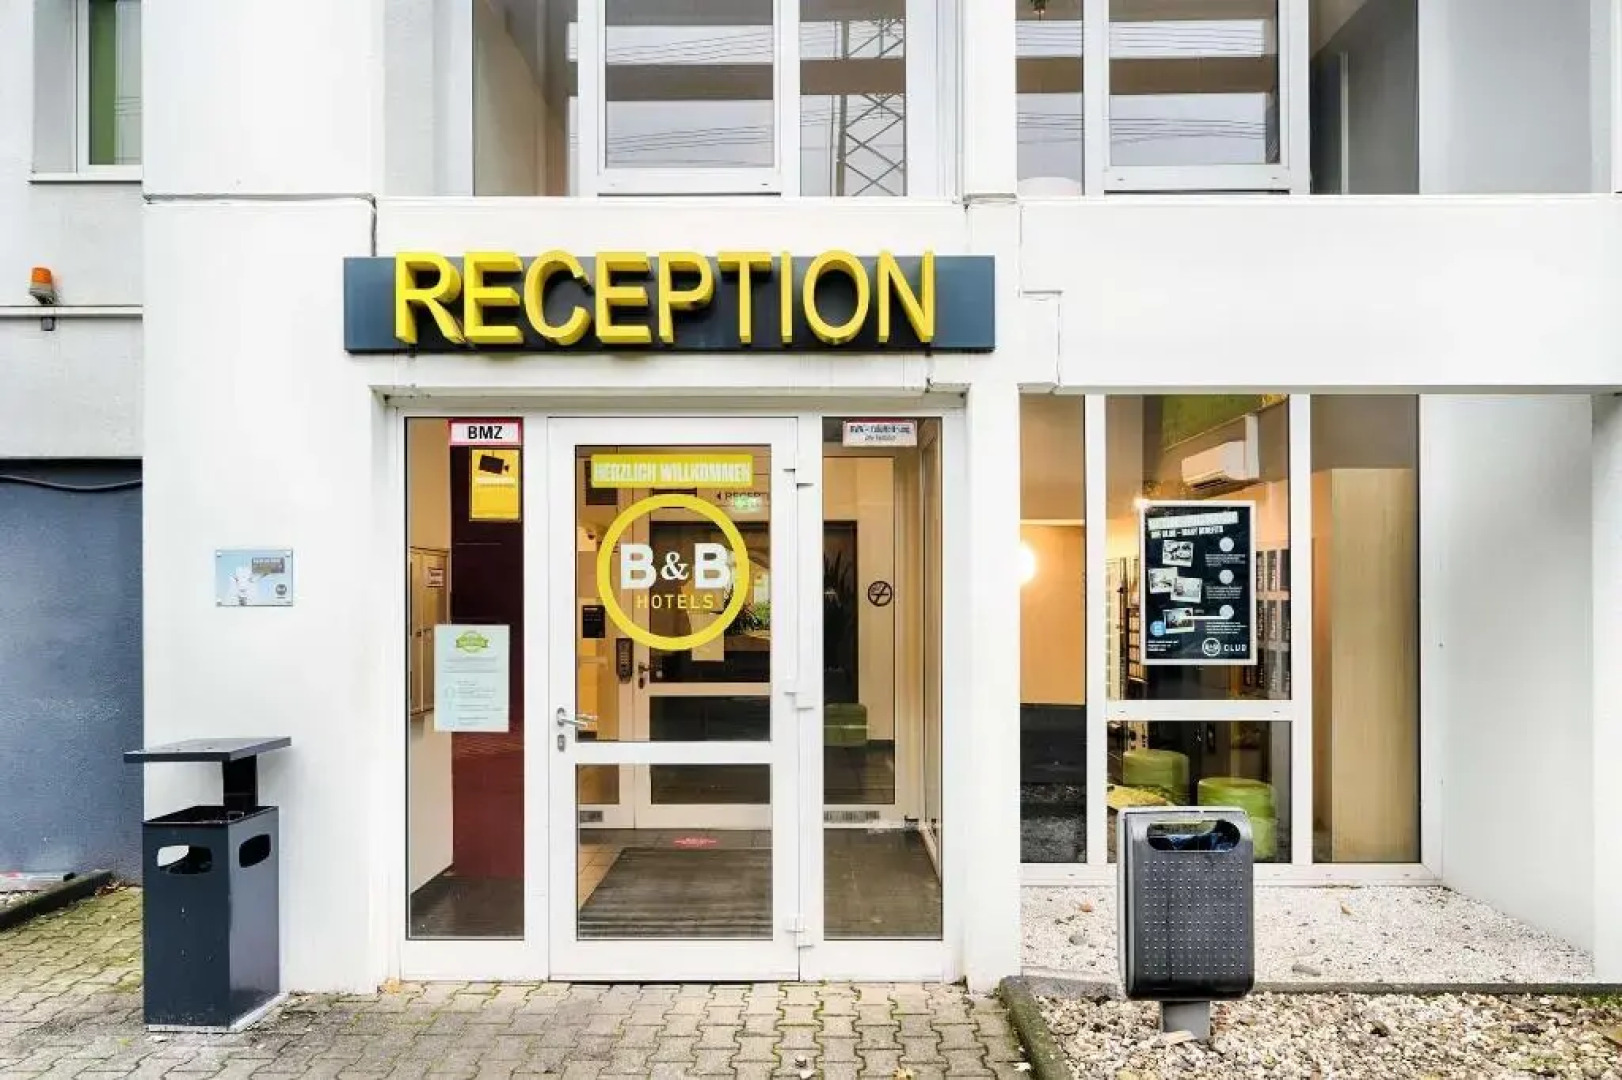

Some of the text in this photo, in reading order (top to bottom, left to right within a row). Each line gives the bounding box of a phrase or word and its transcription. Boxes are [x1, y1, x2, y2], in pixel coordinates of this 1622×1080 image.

[394, 250, 937, 346] RECEPTION
[467, 425, 503, 440] BMZ
[620, 542, 731, 590] B&B
[636, 594, 714, 609] HOTELS
